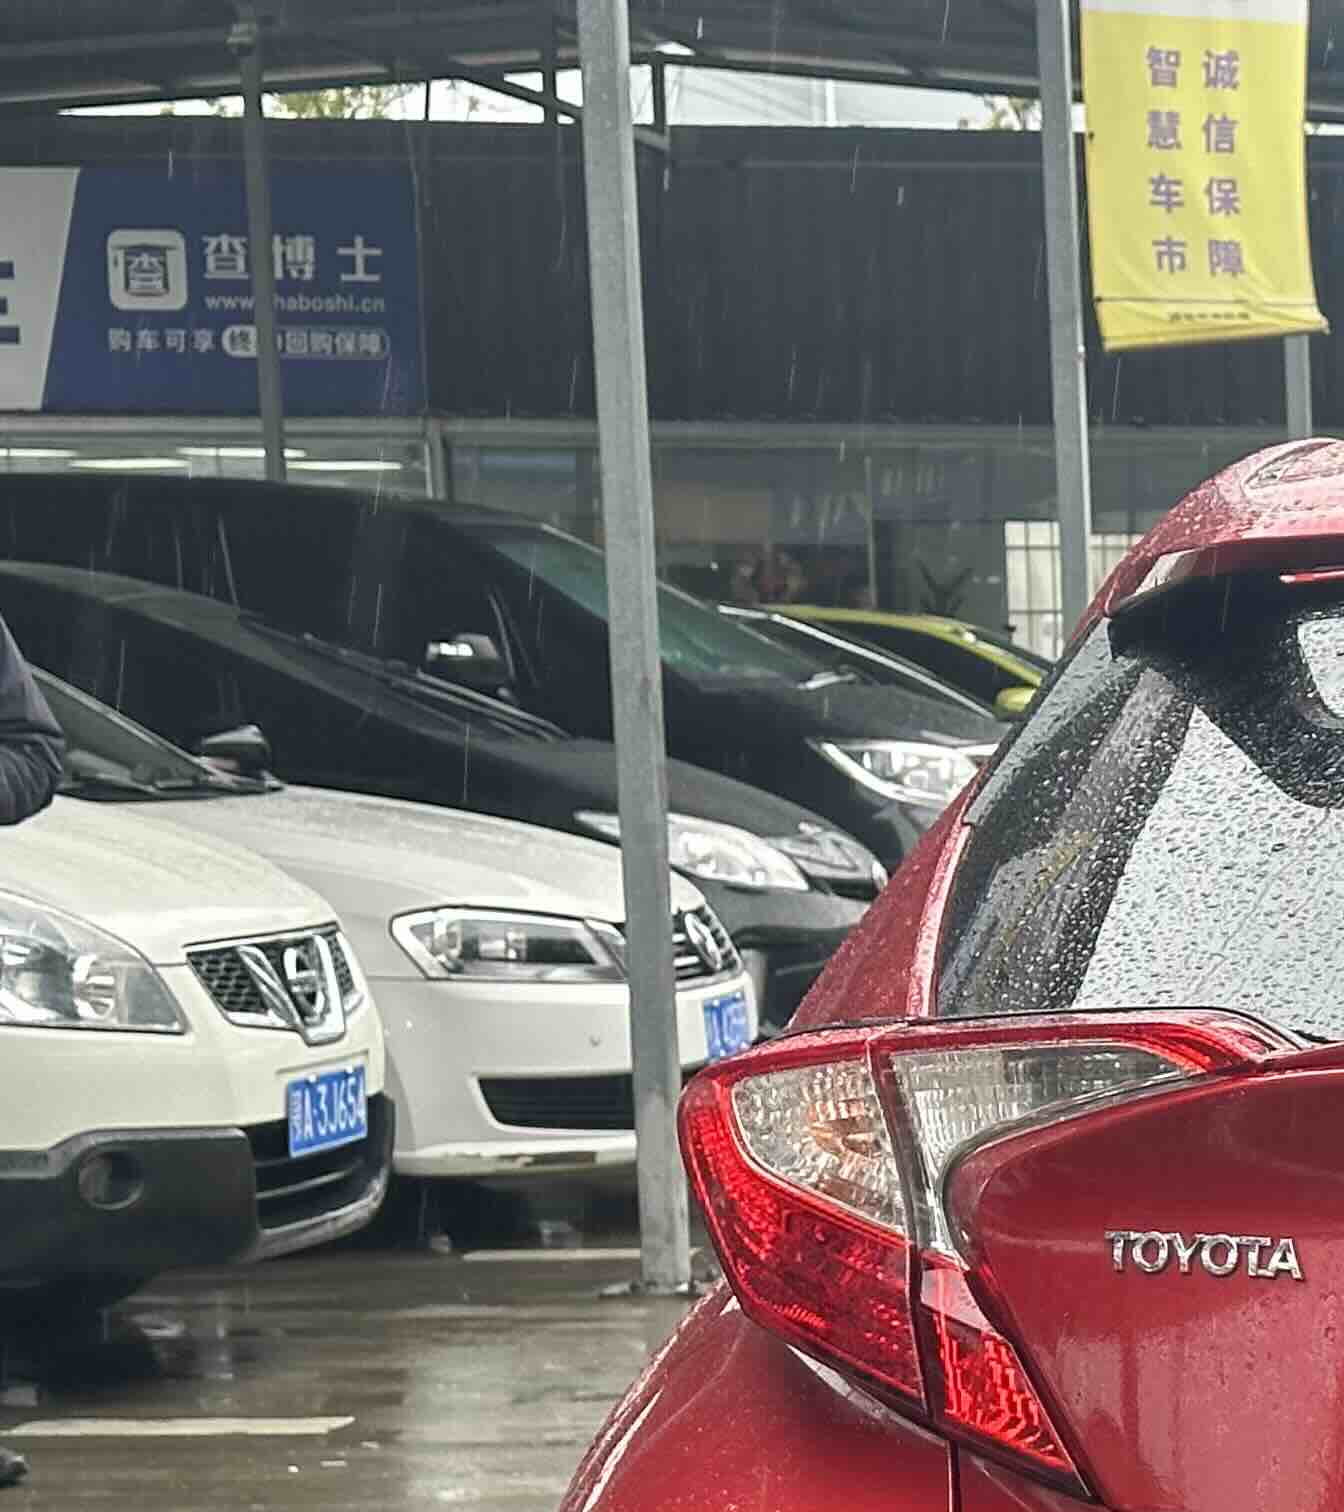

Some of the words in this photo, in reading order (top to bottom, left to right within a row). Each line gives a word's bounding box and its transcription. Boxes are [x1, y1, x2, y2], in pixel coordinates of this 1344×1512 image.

[1146, 46, 1188, 275] 智慧车市
[1202, 50, 1245, 277] 诚信保障
[202, 233, 384, 282] 查博士
[1104, 1230, 1304, 1281] TOYOTA
